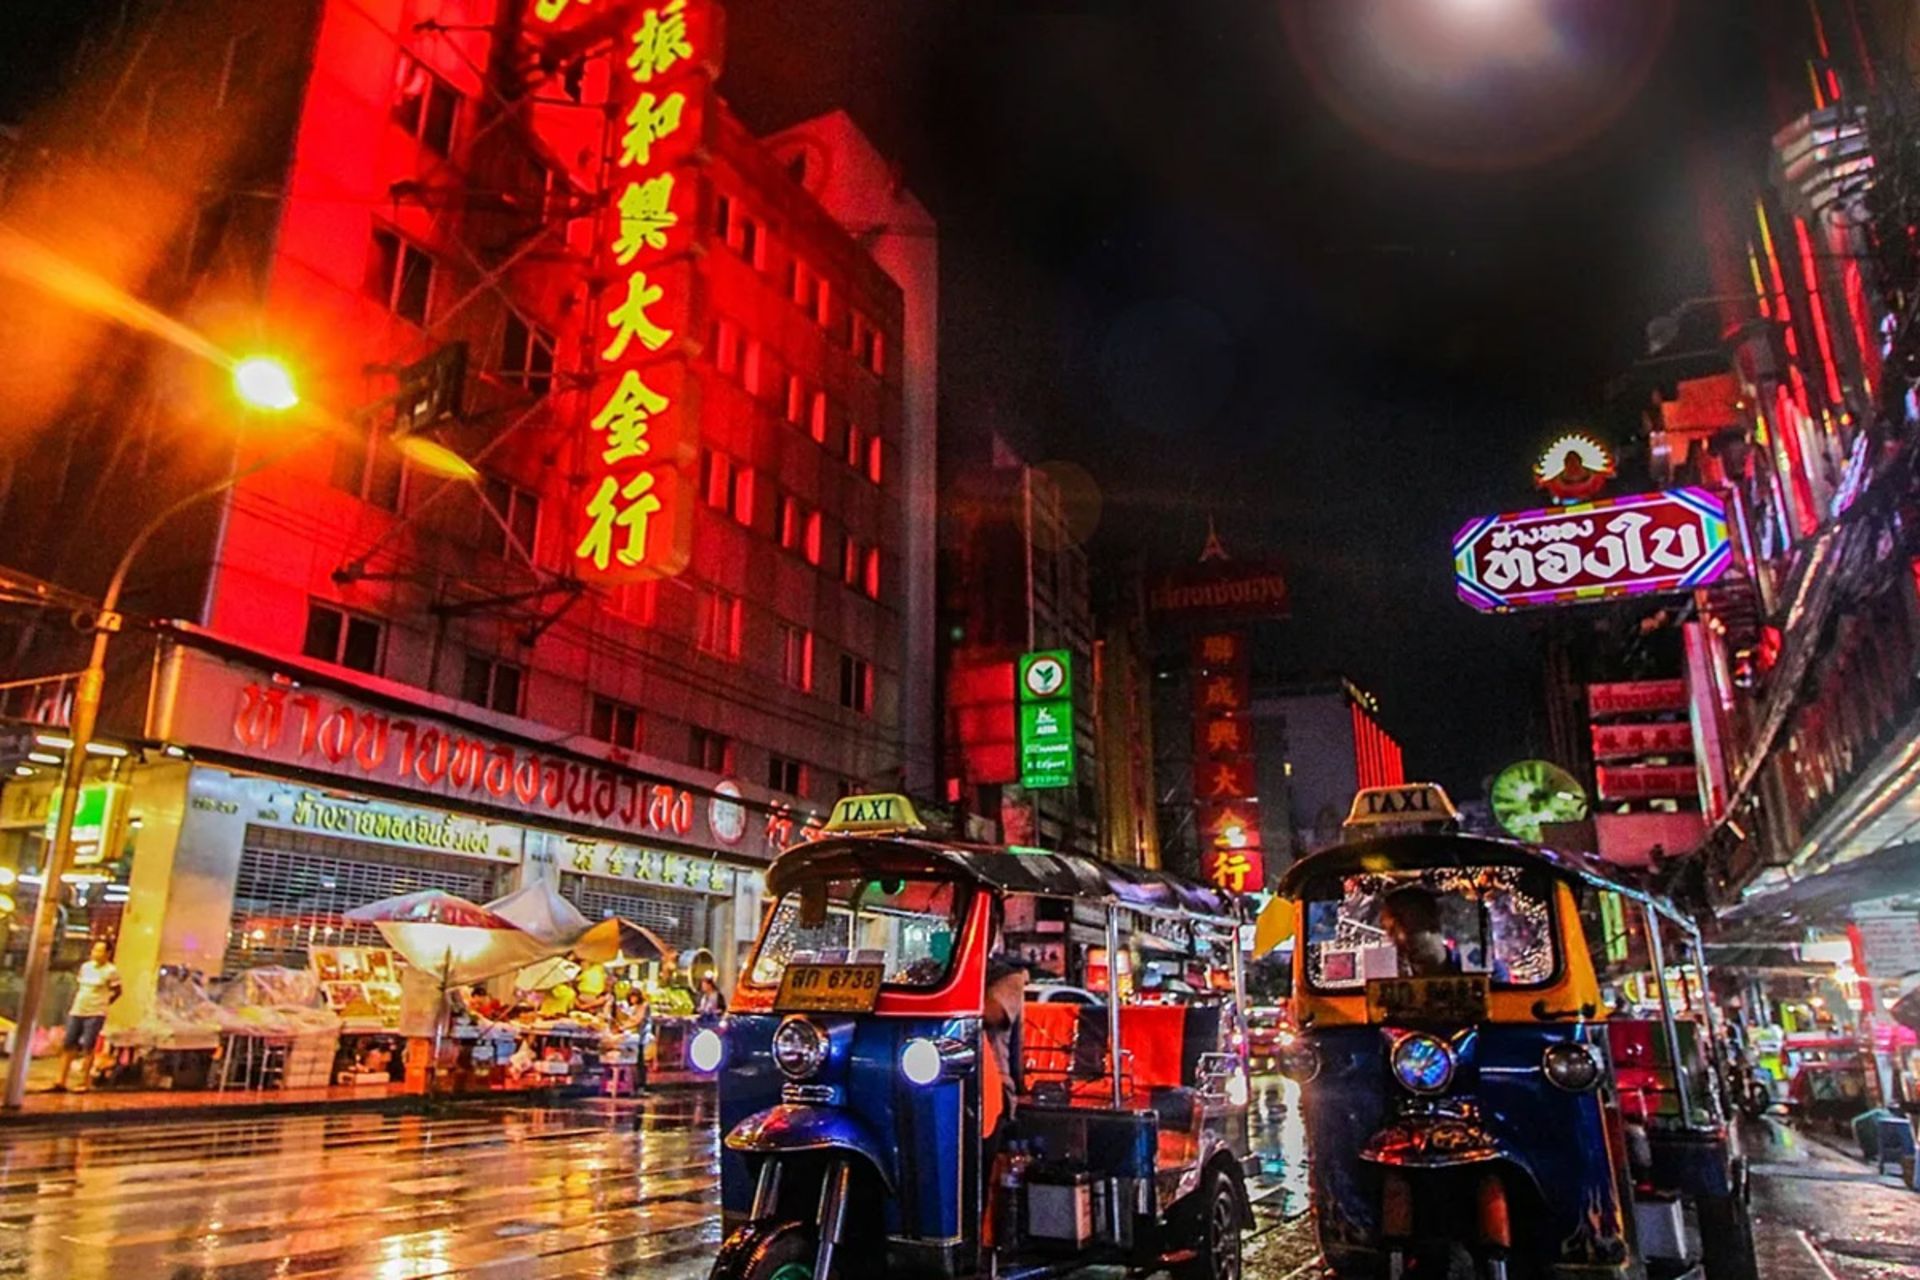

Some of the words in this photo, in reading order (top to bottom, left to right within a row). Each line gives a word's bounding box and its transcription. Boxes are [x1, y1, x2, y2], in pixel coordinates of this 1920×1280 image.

[1483, 512, 1702, 590] ทองใบ
[842, 800, 892, 821] TAXI
[1367, 788, 1431, 813] TAXI
[828, 970, 876, 989] 6738
